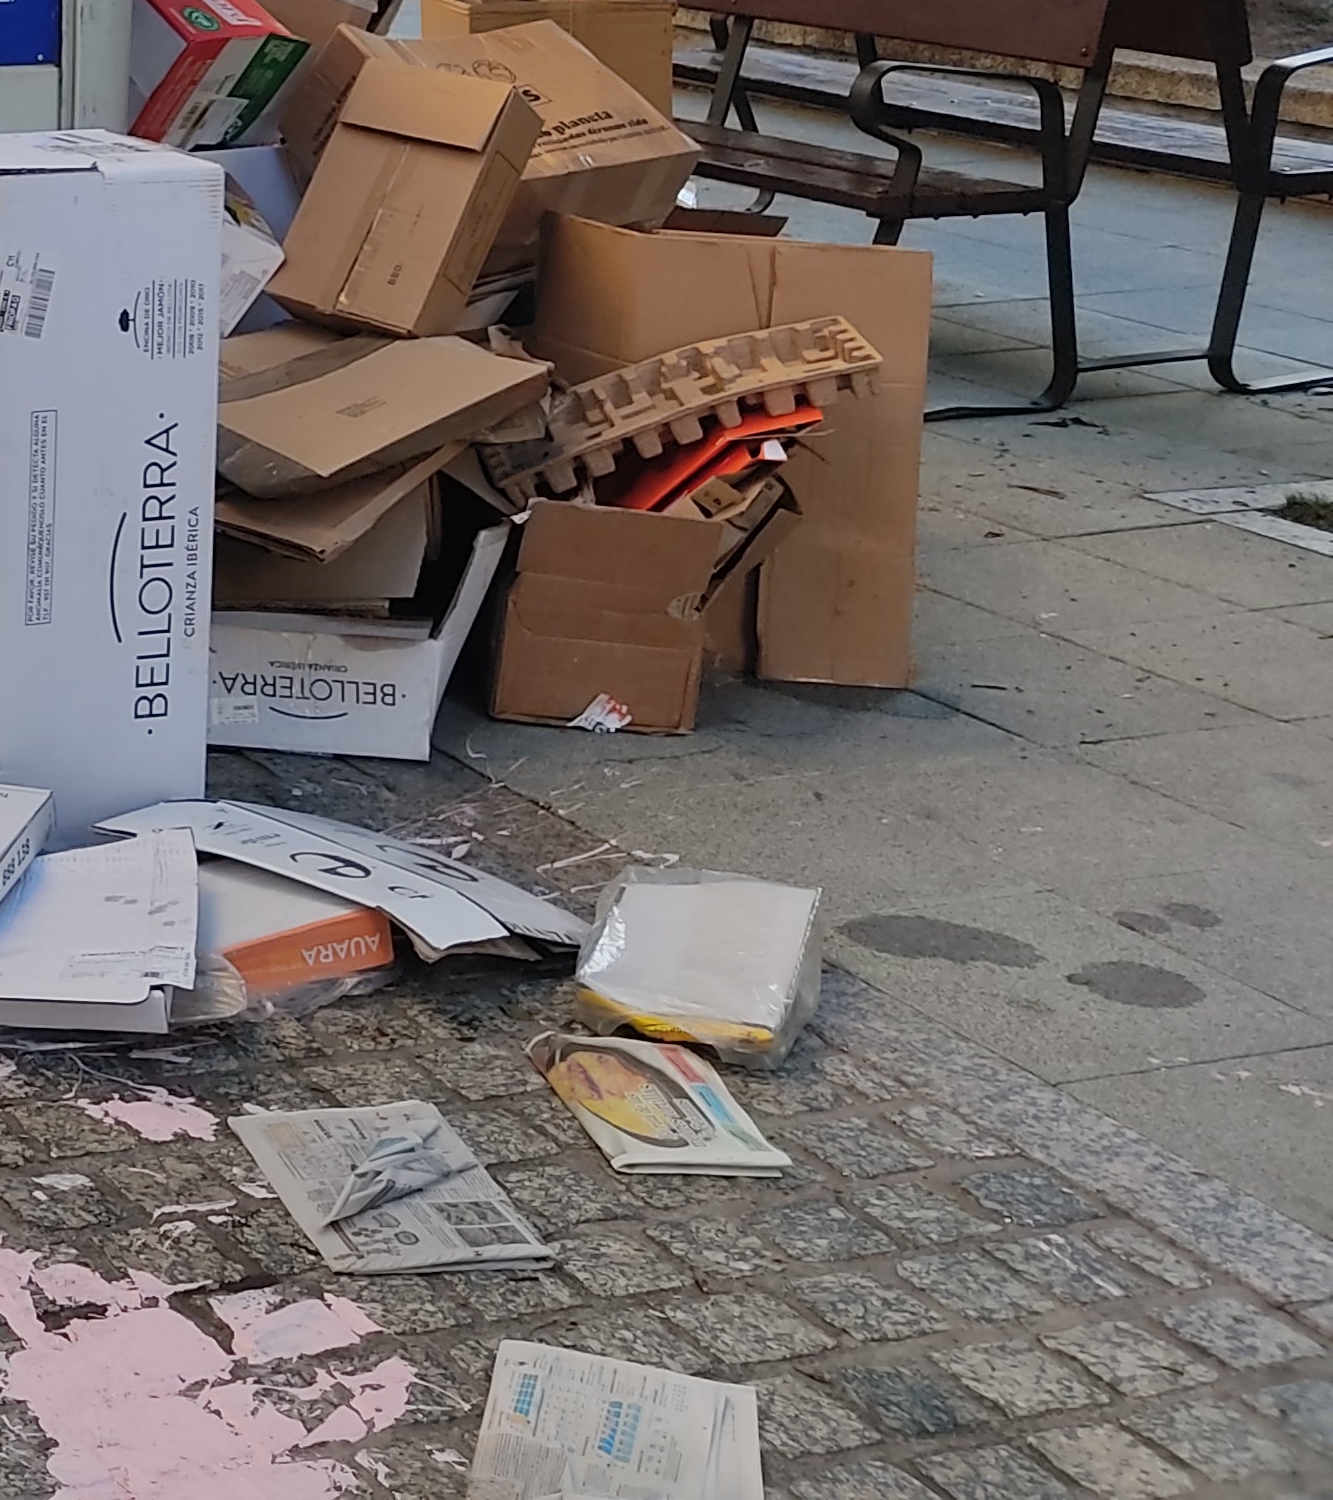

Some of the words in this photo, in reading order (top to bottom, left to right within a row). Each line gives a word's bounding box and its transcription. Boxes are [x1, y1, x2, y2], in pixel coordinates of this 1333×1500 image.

[156, 283, 165, 318] JAMÓN
[156, 321, 164, 355] MEJOR
[185, 506, 200, 567] IBÉRICA
[133, 422, 179, 720] BELLOTERRA
[183, 570, 198, 638] CRIANZA
[218, 671, 397, 707] BELLOTERRA
[299, 930, 381, 967] AUARA
